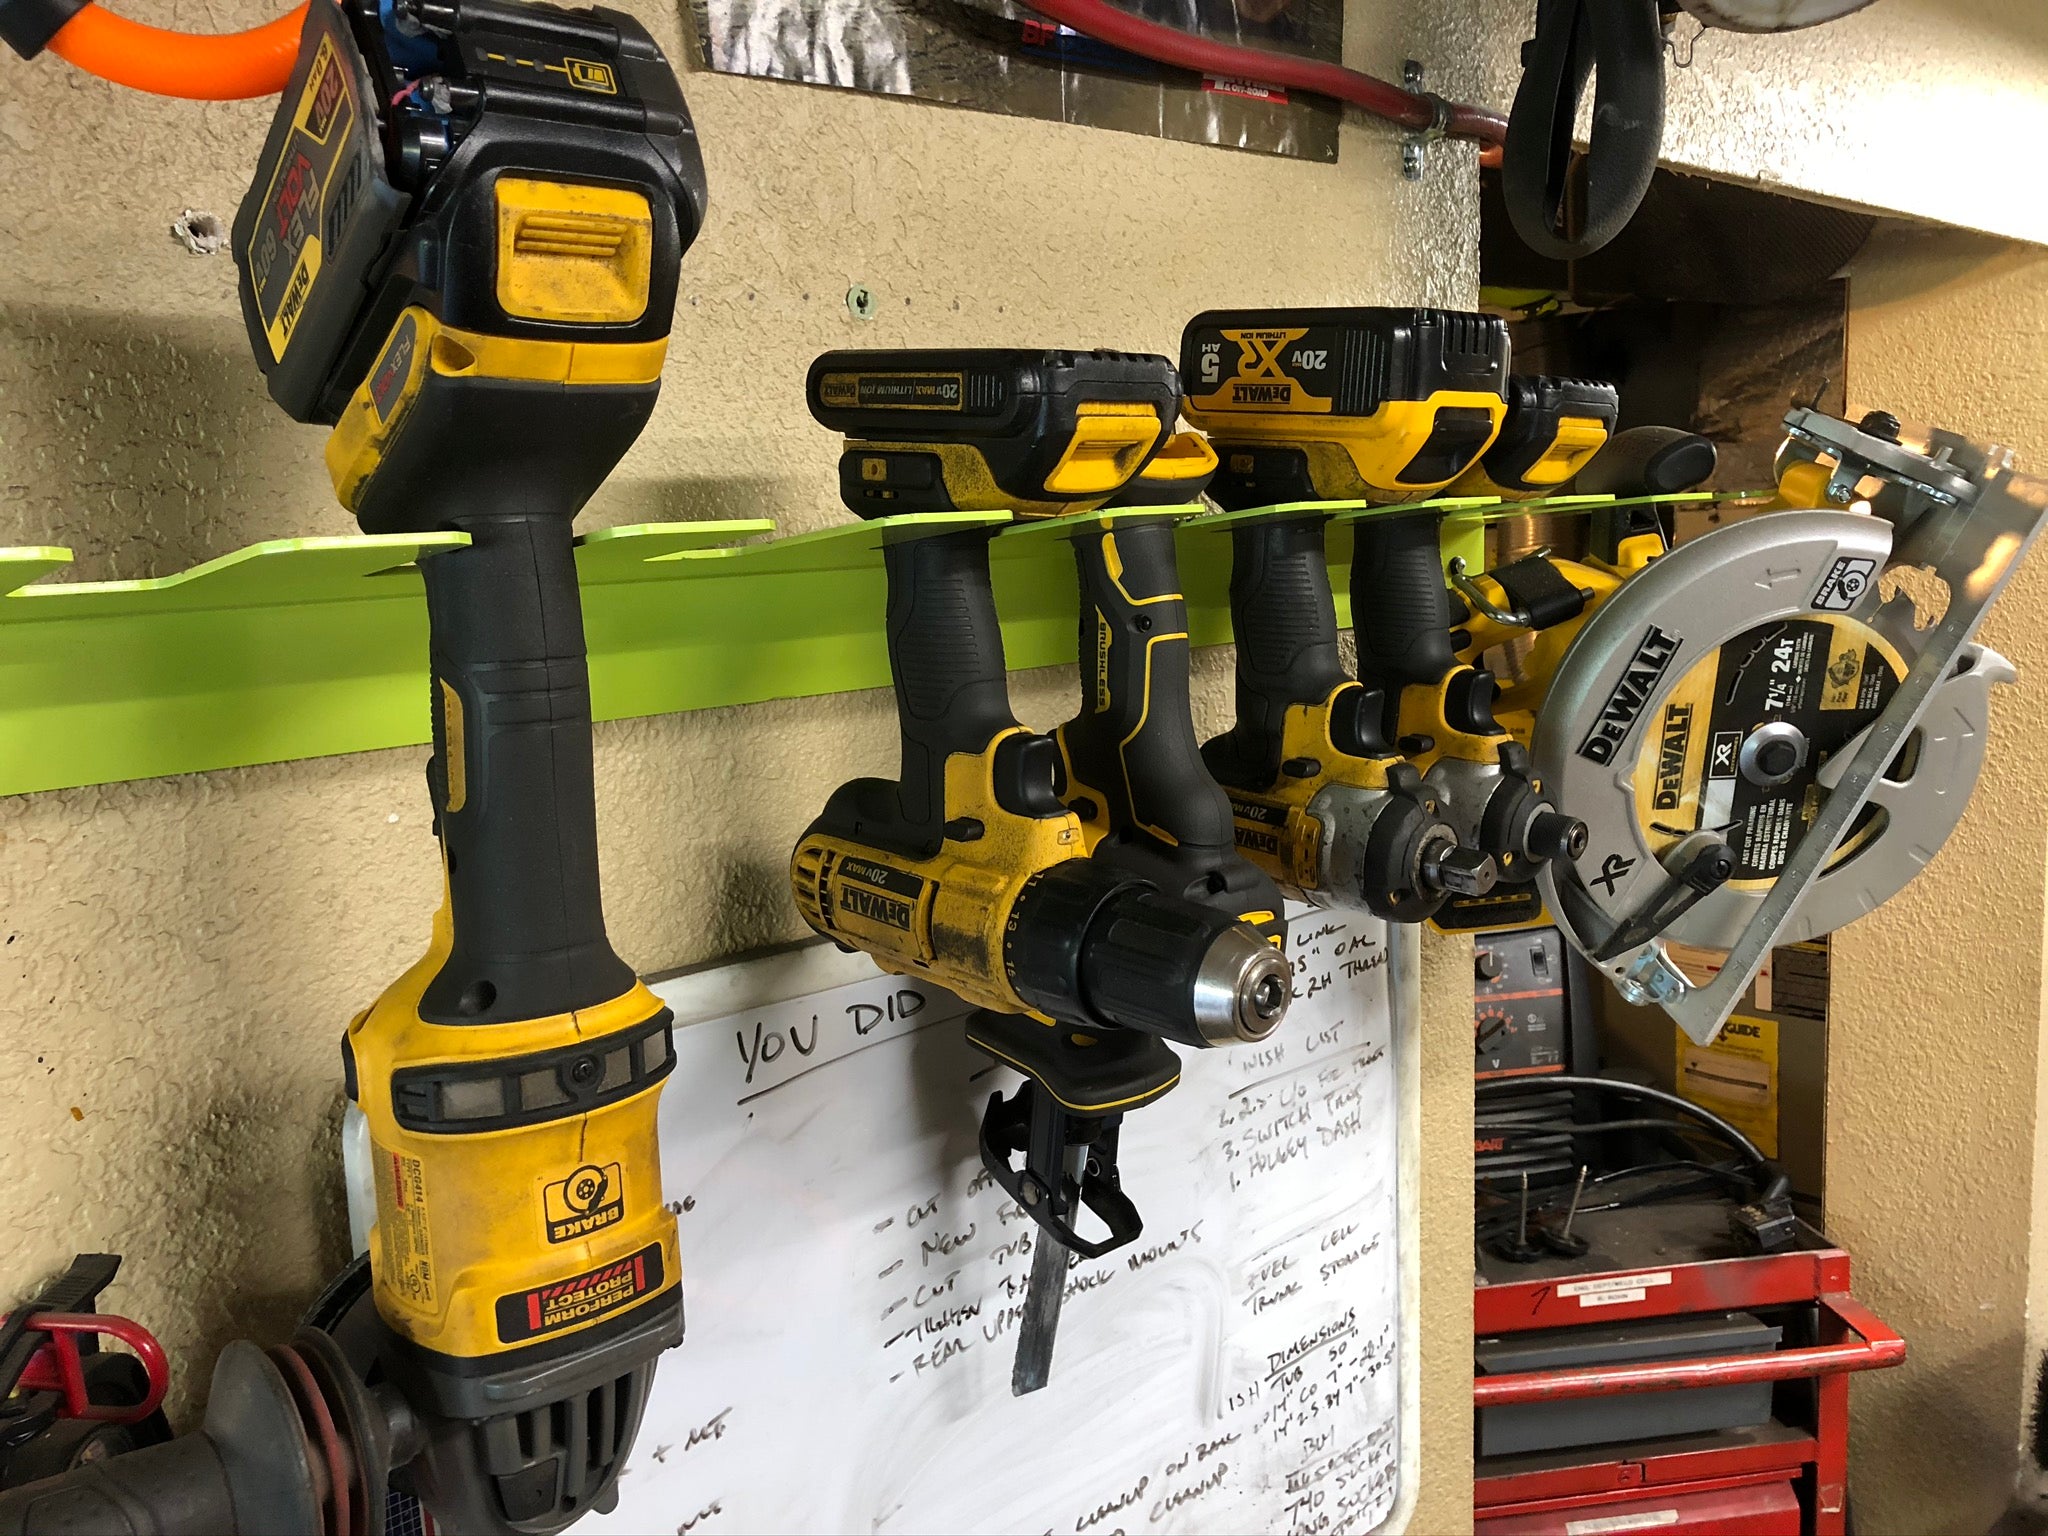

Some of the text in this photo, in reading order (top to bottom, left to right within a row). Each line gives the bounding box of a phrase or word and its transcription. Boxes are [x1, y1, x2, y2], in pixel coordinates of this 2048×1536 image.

[276, 152, 313, 240] VOLT
[281, 166, 321, 267] FLEX
[279, 260, 311, 340] DEWALT
[1202, 343, 1221, 353] AH
[1240, 331, 1287, 340] LITHIUM ION
[1201, 352, 1220, 383] 5
[1237, 340, 1290, 378] XR
[1232, 385, 1291, 403] DEWALT
[1815, 558, 1847, 606] BRAKE
[1097, 622, 1107, 708] BRUSHLESS
[1771, 639, 1794, 673] 24T
[1578, 623, 1684, 767] DEWALT
[1653, 702, 1694, 810] DEWALT
[1715, 742, 1732, 766] XR
[1742, 849, 1750, 864] FAST
[1744, 836, 1752, 848] CUT
[1751, 843, 1761, 867] CORTES
[1759, 843, 1769, 870] MADERA
[1769, 845, 1778, 869] COUPES
[1590, 853, 1637, 897] XR
[841, 886, 910, 931] DEWALT
[737, 989, 926, 1083] YOU DID
[1306, 1020, 1344, 1051] LIST
[1243, 1103, 1311, 1147] SWITCH
[1316, 1107, 1361, 1147] DASH
[412, 1159, 424, 1203] DCG414
[554, 1206, 619, 1240] BRAKE
[1320, 1223, 1360, 1252] CELL
[921, 1223, 976, 1267] NEW
[544, 1284, 634, 1326] PERFORM
[545, 1270, 633, 1310] PROTECT
[913, 1269, 961, 1308] CUT
[982, 1305, 1024, 1342] UPPE
[1266, 1307, 1356, 1374] DIMENSIONS
[1271, 1366, 1304, 1392] TUB
